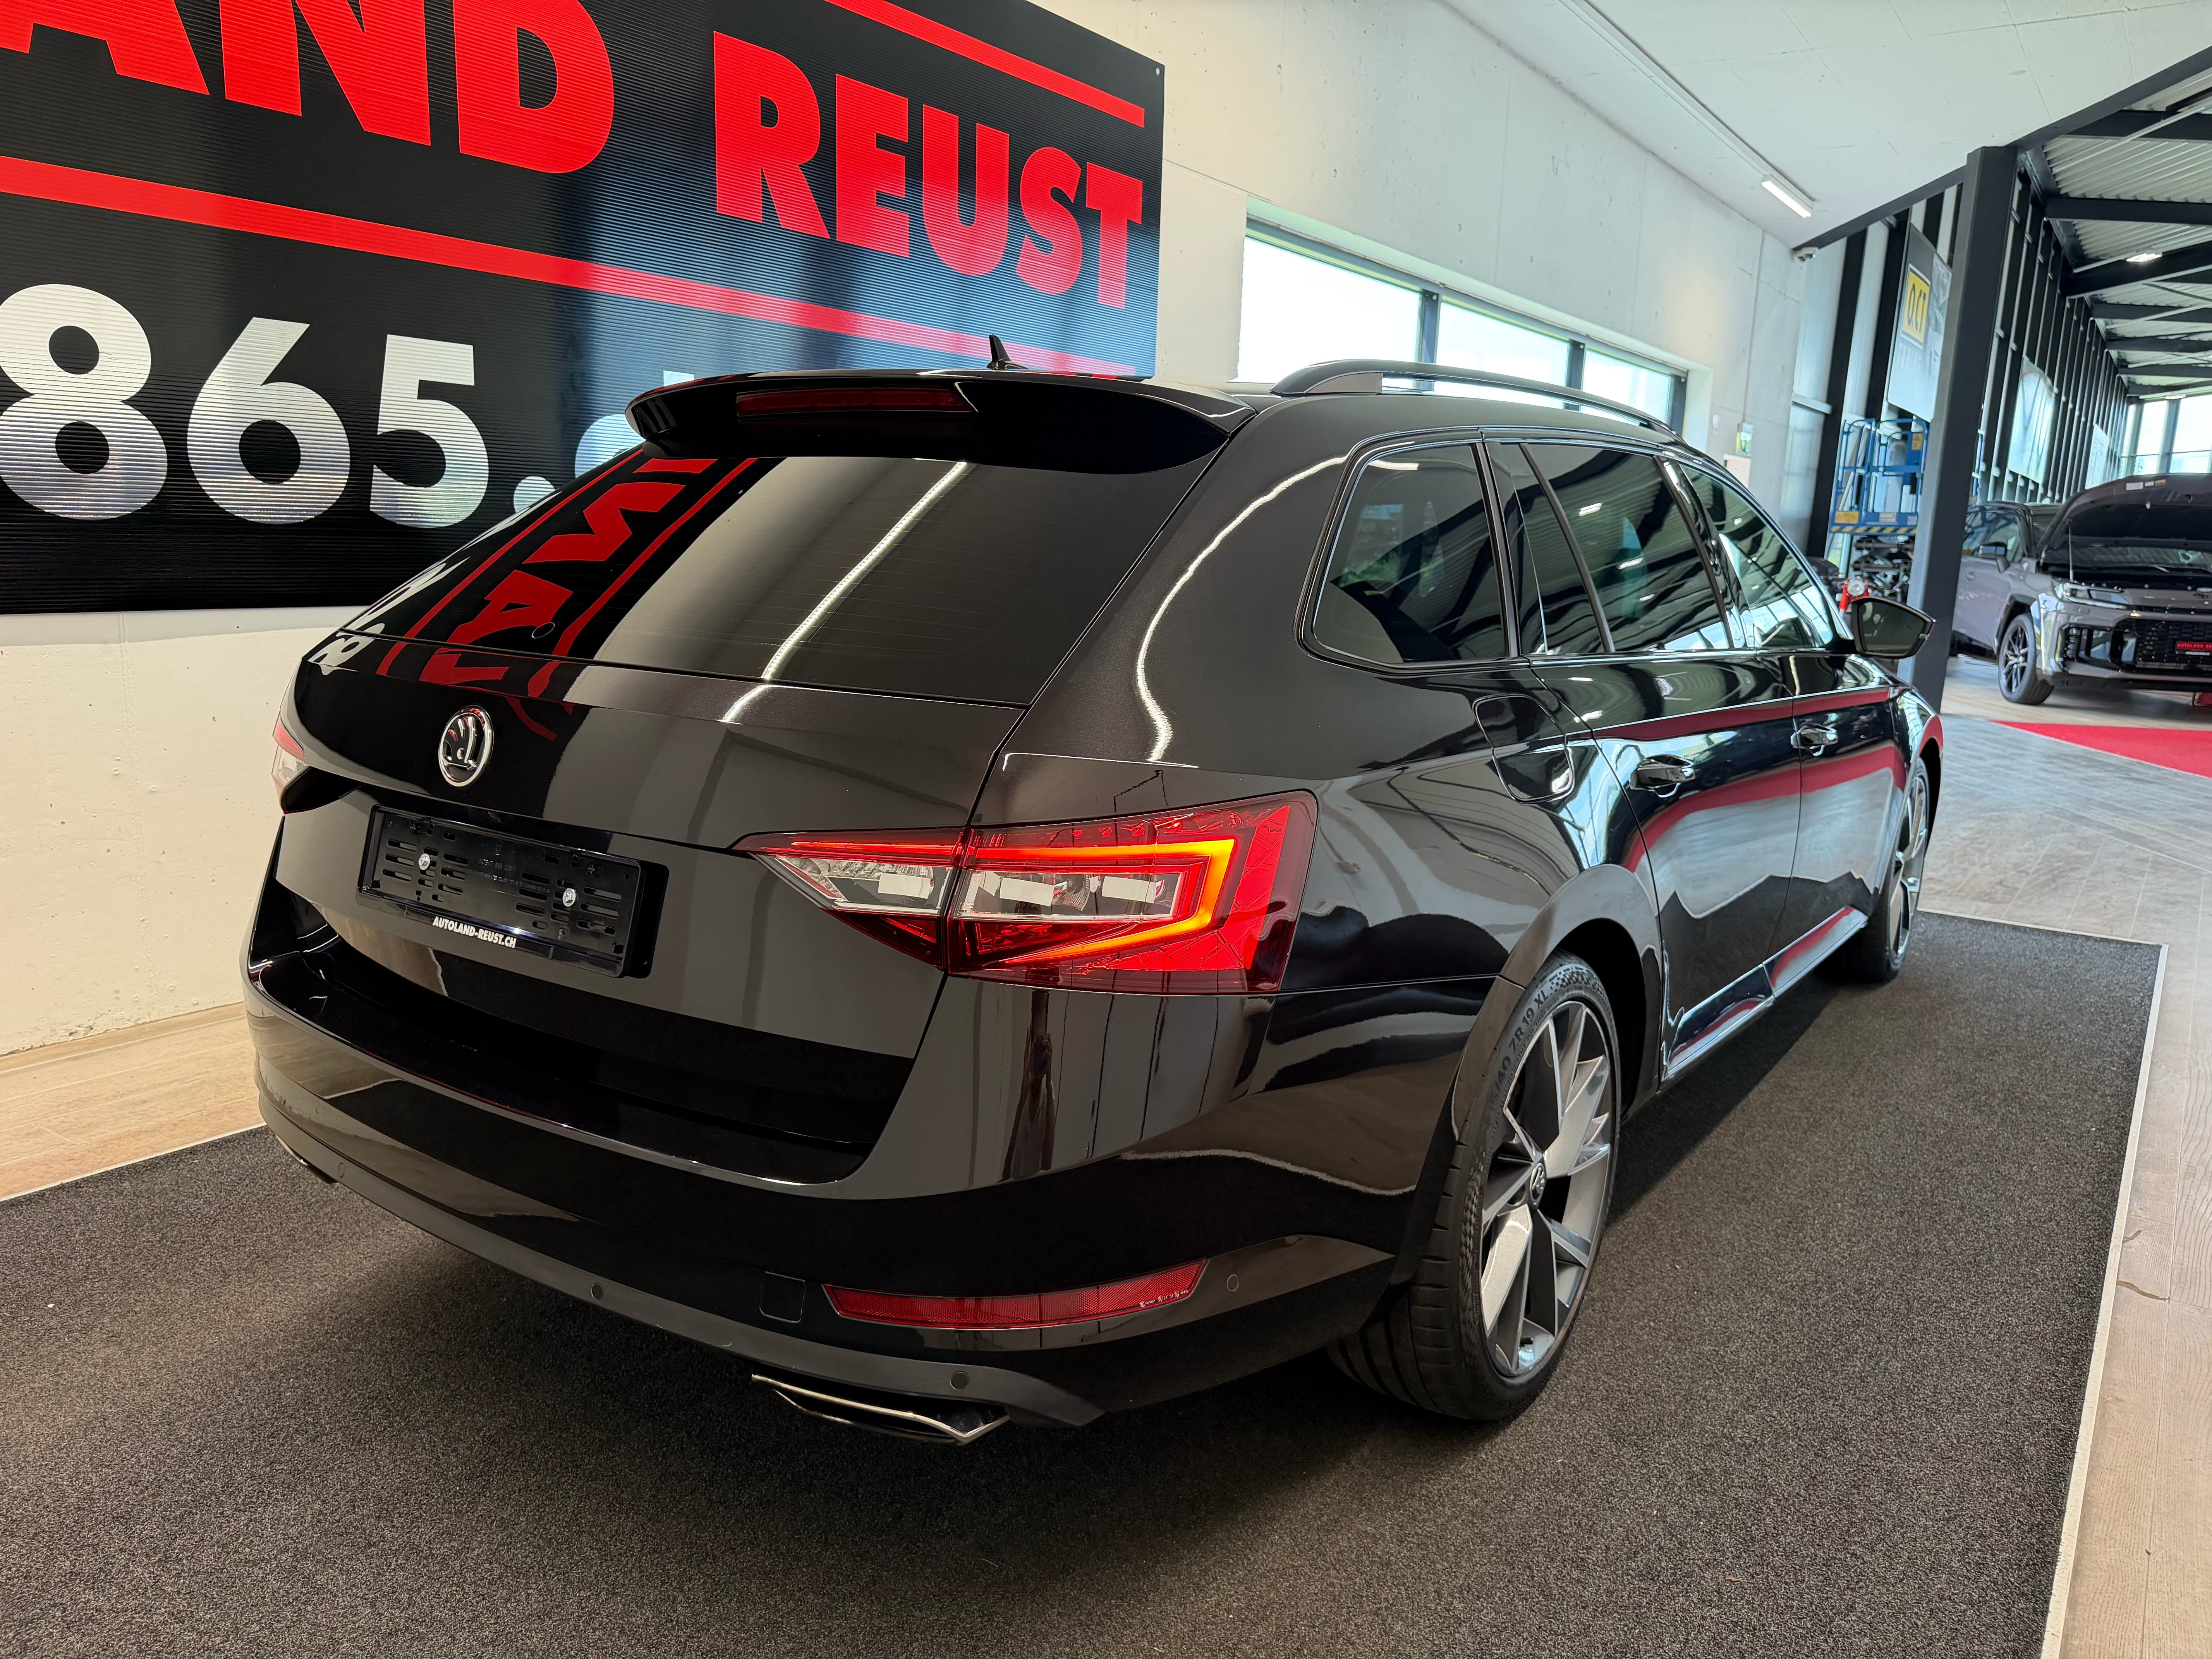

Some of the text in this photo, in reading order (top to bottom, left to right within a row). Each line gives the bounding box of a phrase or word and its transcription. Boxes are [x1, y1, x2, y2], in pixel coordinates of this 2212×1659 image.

[713, 30, 1143, 309] REUST
[432, 916, 517, 948] AUTOLAND-REUST.CH
[1509, 1026, 1525, 1054] ZR
[1522, 1007, 1534, 1026] 19
[1533, 989, 1549, 1010] XL
